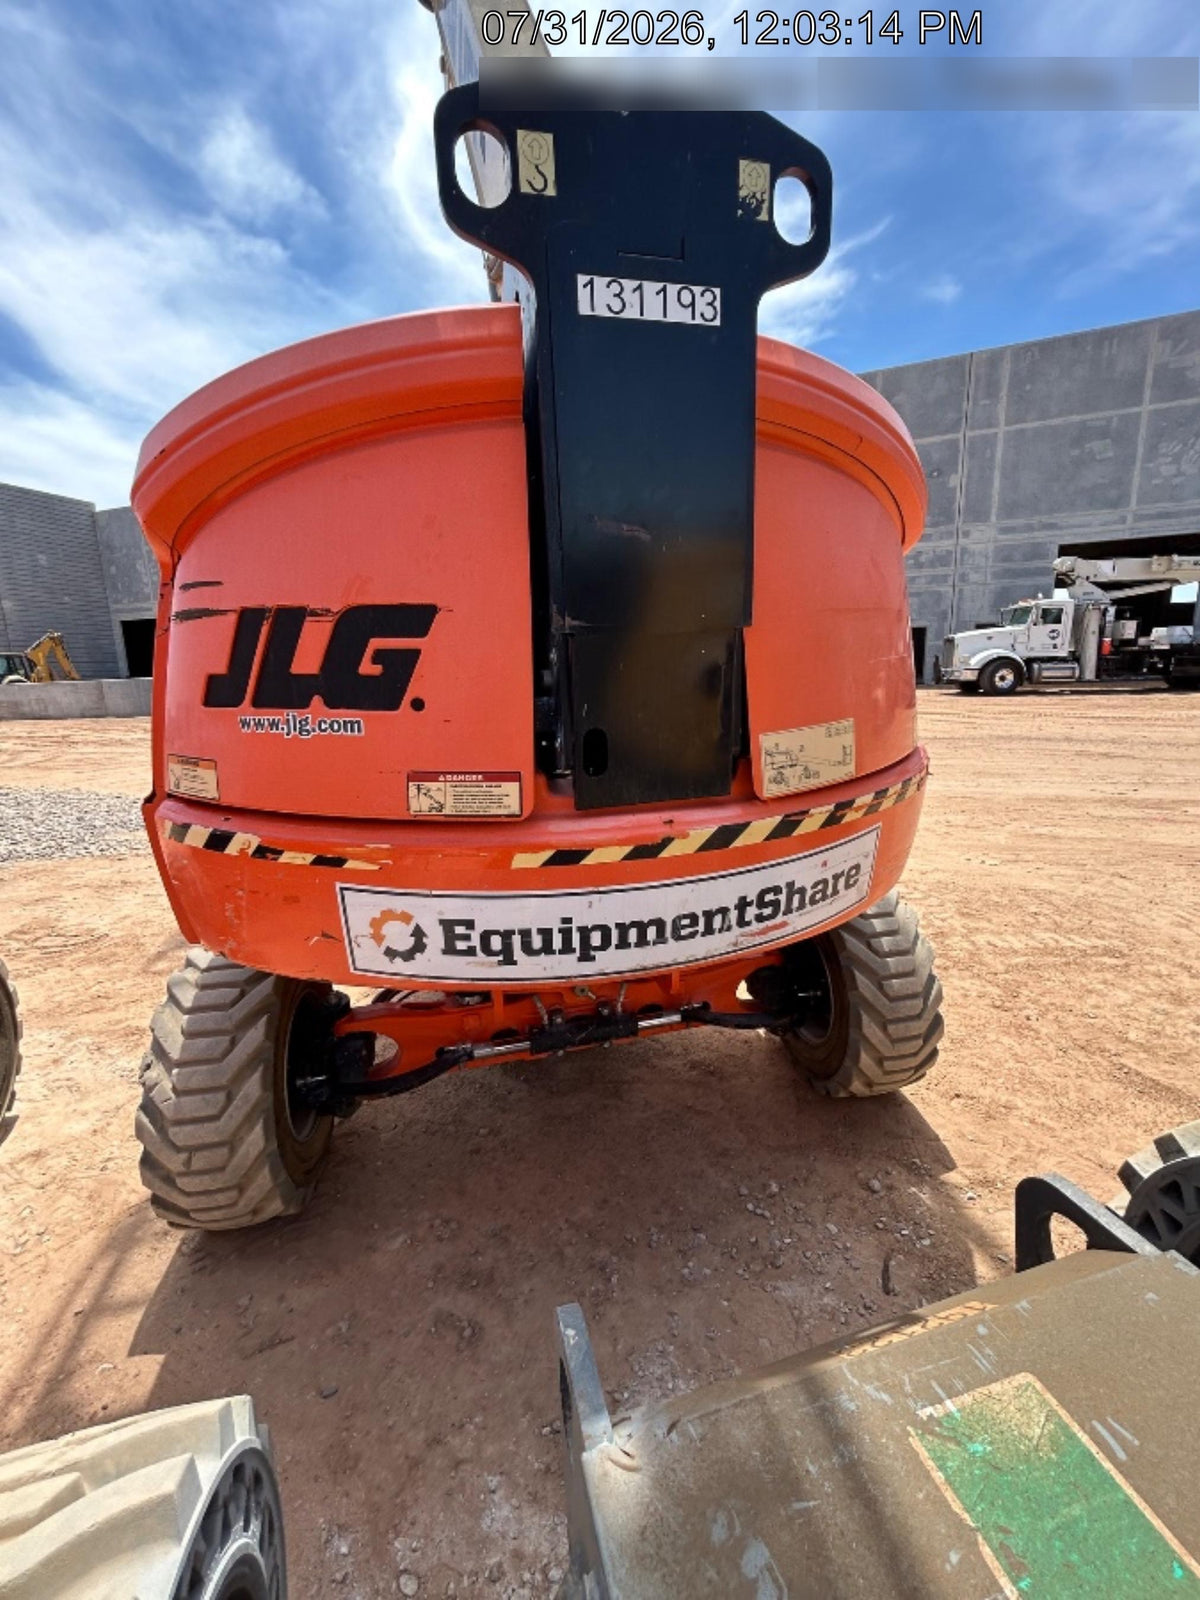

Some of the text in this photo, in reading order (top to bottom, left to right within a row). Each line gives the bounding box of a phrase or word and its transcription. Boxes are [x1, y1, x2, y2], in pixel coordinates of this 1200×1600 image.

[582, 276, 718, 322] 131193
[239, 712, 364, 738] www.jlg.com
[438, 861, 861, 966] EquipmentShare
